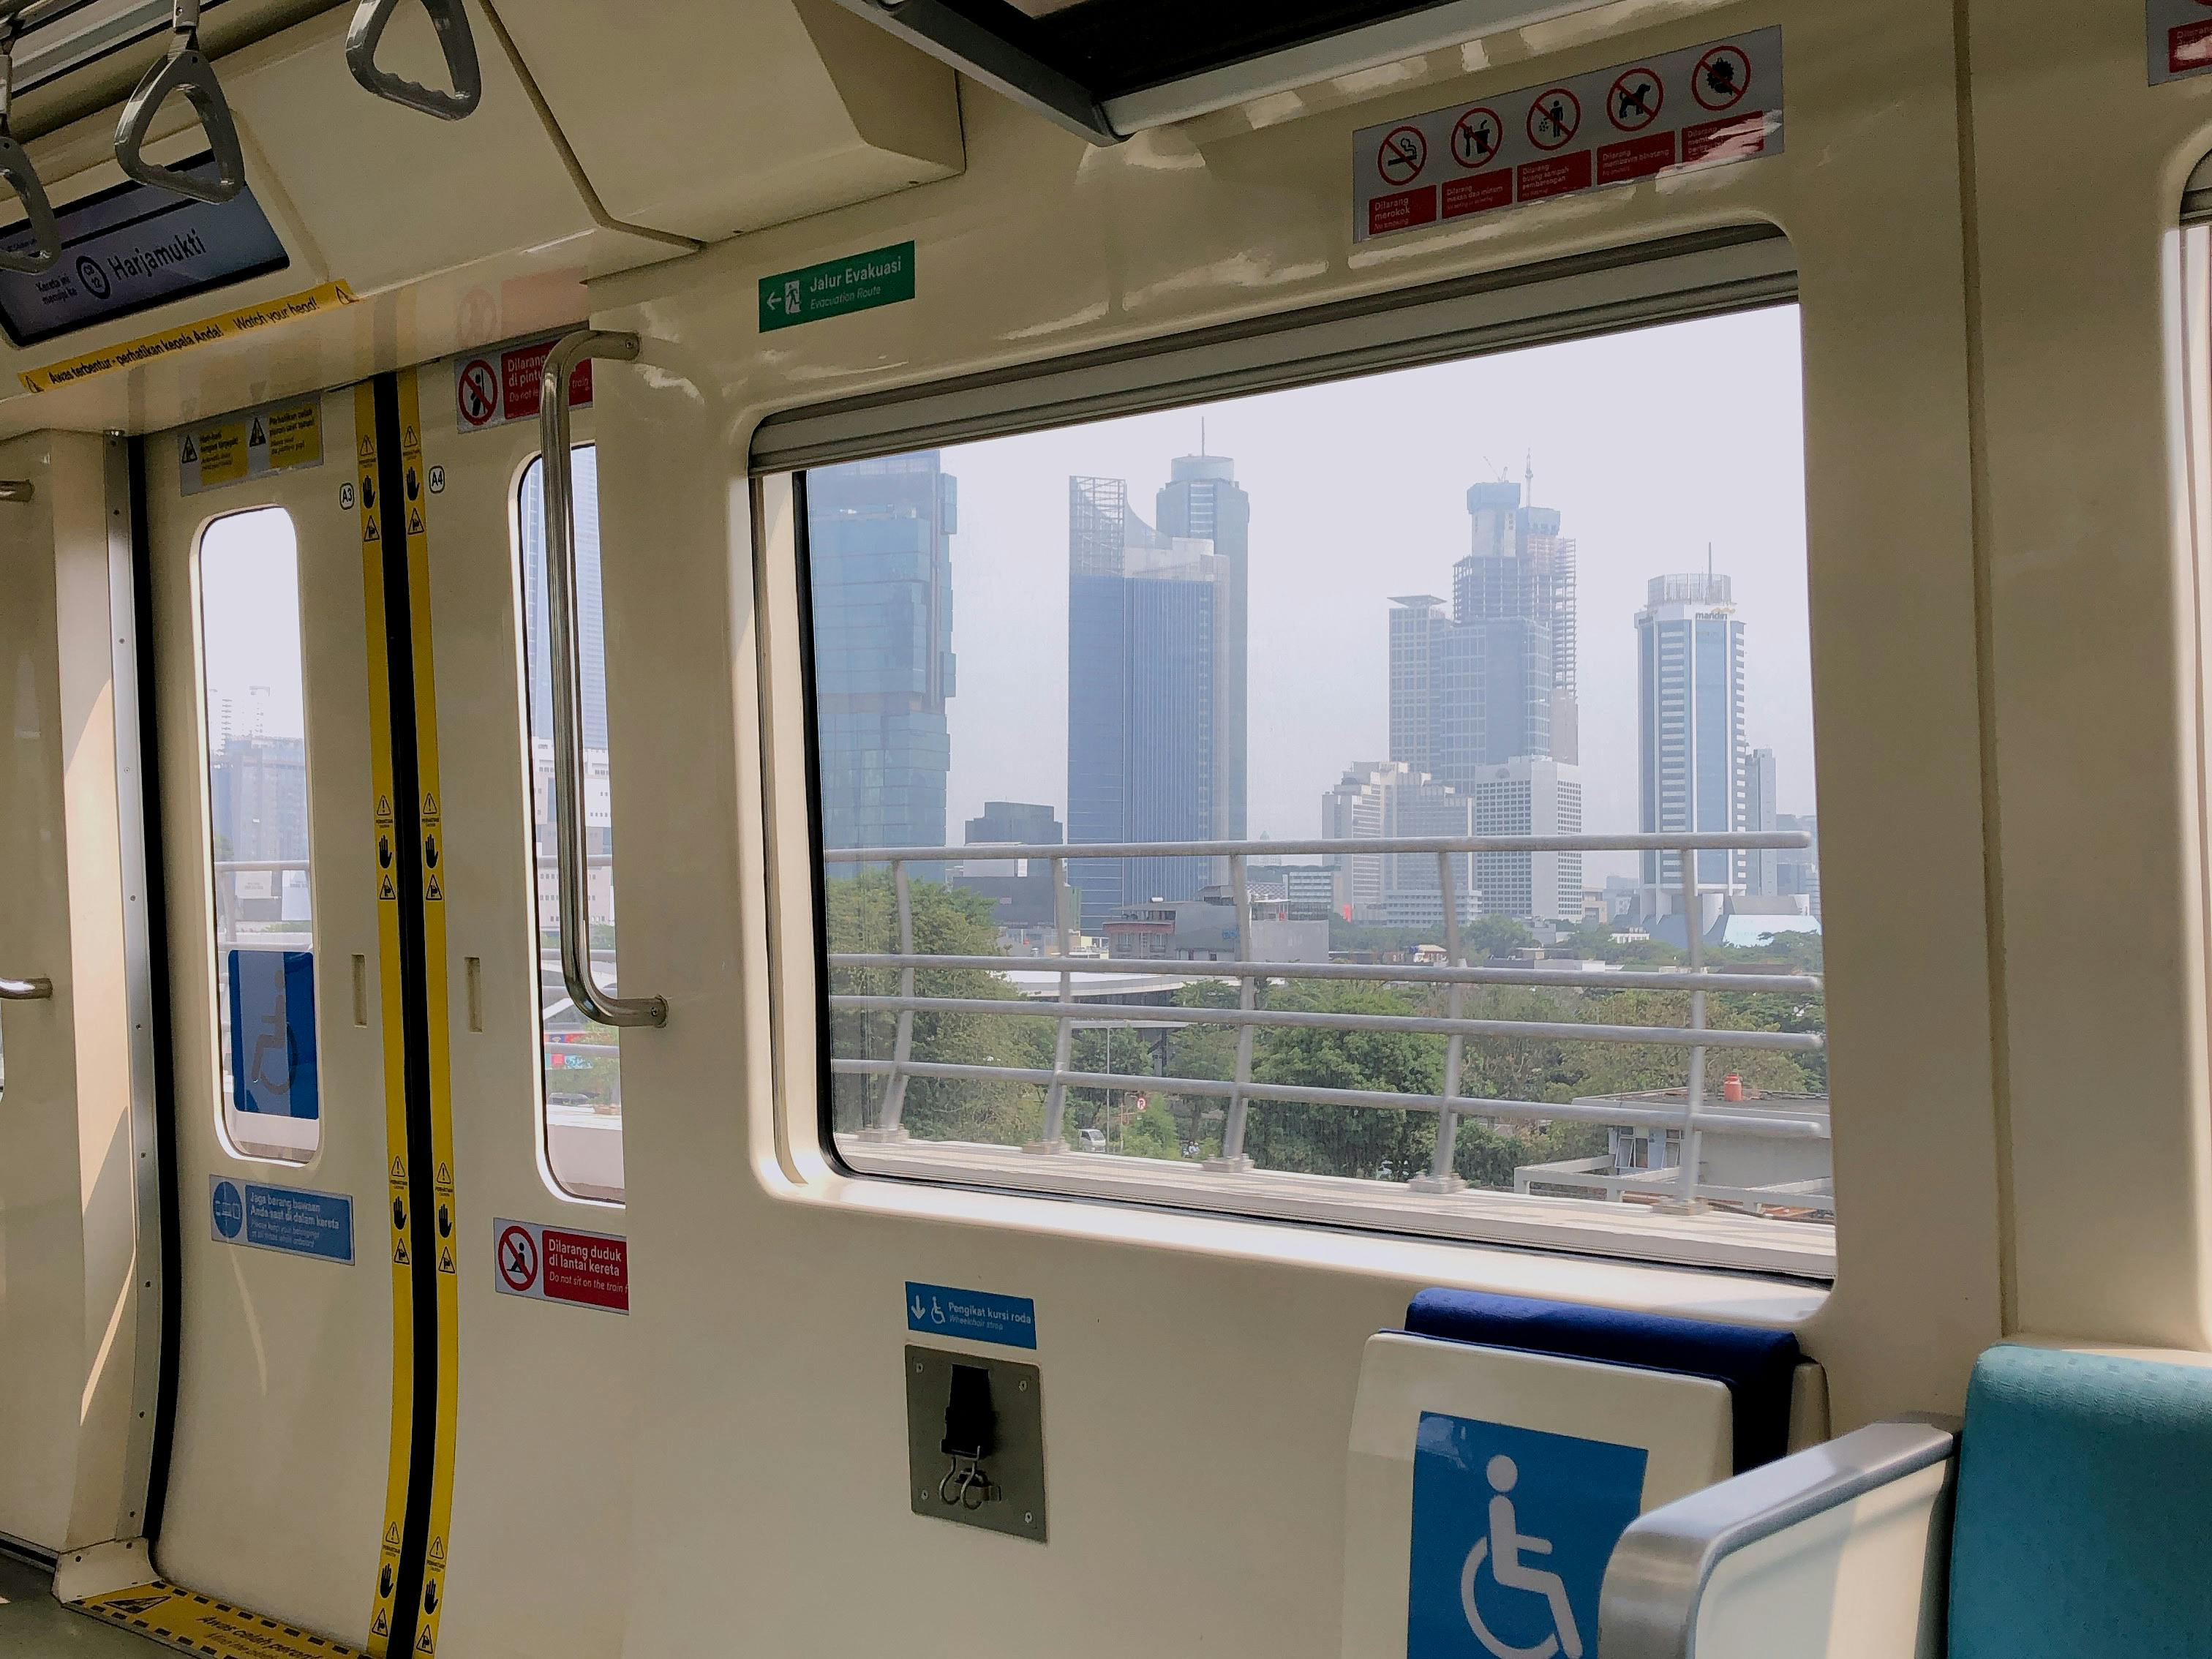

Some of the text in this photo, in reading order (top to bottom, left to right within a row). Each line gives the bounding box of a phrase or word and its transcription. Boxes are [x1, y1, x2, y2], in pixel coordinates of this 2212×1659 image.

[1603, 150, 1631, 161] Dilarang
[1522, 163, 1549, 175] Dilarang
[1447, 185, 1472, 196] Dilarang
[1374, 197, 1409, 211] Dilarang
[1374, 206, 1410, 221] merokok
[108, 228, 206, 280] Harjamukti
[91, 276, 102, 288] 12
[810, 256, 902, 293] Jalur Evakuasi
[810, 285, 881, 310] Evacuation Route
[48, 369, 74, 384] Awas
[72, 358, 112, 379] terbentur
[116, 343, 164, 366] perhatikan
[160, 333, 195, 353] kepala
[192, 324, 225, 344] Anda!
[233, 312, 268, 330] Watch
[268, 307, 289, 323] your
[287, 296, 320, 316] head!
[508, 372, 518, 387] di
[510, 392, 519, 402] Do
[431, 470, 443, 487] A4
[342, 488, 353, 503] A3
[250, 1192, 267, 1205] Jaga
[267, 1194, 293, 1210] barang
[250, 1205, 268, 1218] Anda
[293, 1211, 315, 1225] dalam
[316, 1214, 339, 1230] kereta
[549, 1238, 622, 1263] Dilarang duduk
[549, 1254, 620, 1276] di lantai kereta
[549, 1271, 560, 1282] Do
[560, 1275, 572, 1284] not
[573, 1275, 582, 1285] sit
[583, 1279, 592, 1288] on
[593, 1279, 605, 1290] the
[606, 1281, 623, 1293] train
[948, 1301, 1031, 1324] Pengikat kursi roda
[949, 1314, 985, 1328] Wheelchair
